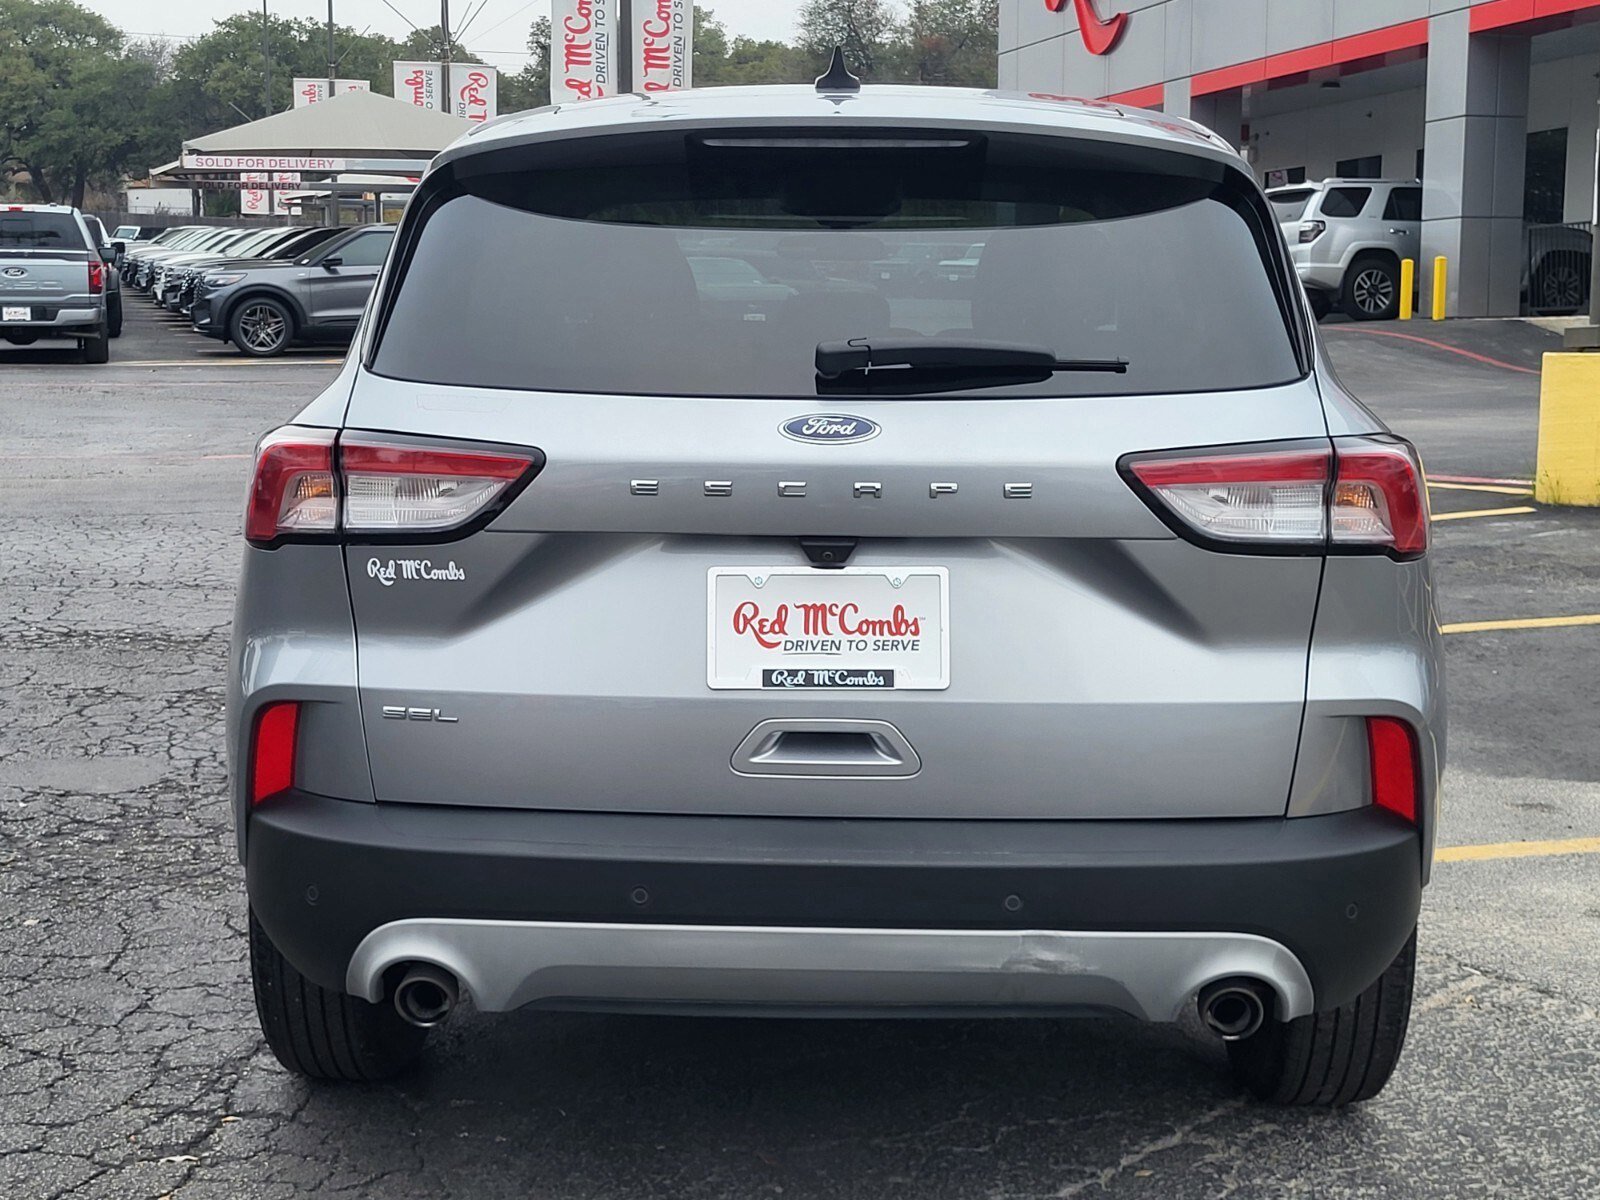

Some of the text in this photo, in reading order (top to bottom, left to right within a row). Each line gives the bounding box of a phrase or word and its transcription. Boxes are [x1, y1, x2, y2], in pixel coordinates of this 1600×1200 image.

[595, 9, 606, 28] TO
[673, 12, 683, 32] TO
[595, 33, 606, 84] DRIVEN
[673, 36, 683, 88] DRIVEN
[425, 70, 433, 99] SERVE
[460, 72, 488, 107] Red
[195, 157, 335, 169] SOLD FOR DELIVERY
[197, 181, 302, 190] SOLD FOR DELIVERY
[802, 417, 857, 435] Ford
[630, 479, 1033, 498] ESCAPE
[367, 557, 466, 586] Red McCombs
[733, 601, 920, 649] Red McCombs
[783, 639, 920, 652] DRIVEN TO SERVE
[771, 669, 884, 688] Red McCombs
[382, 705, 459, 722] SEL
